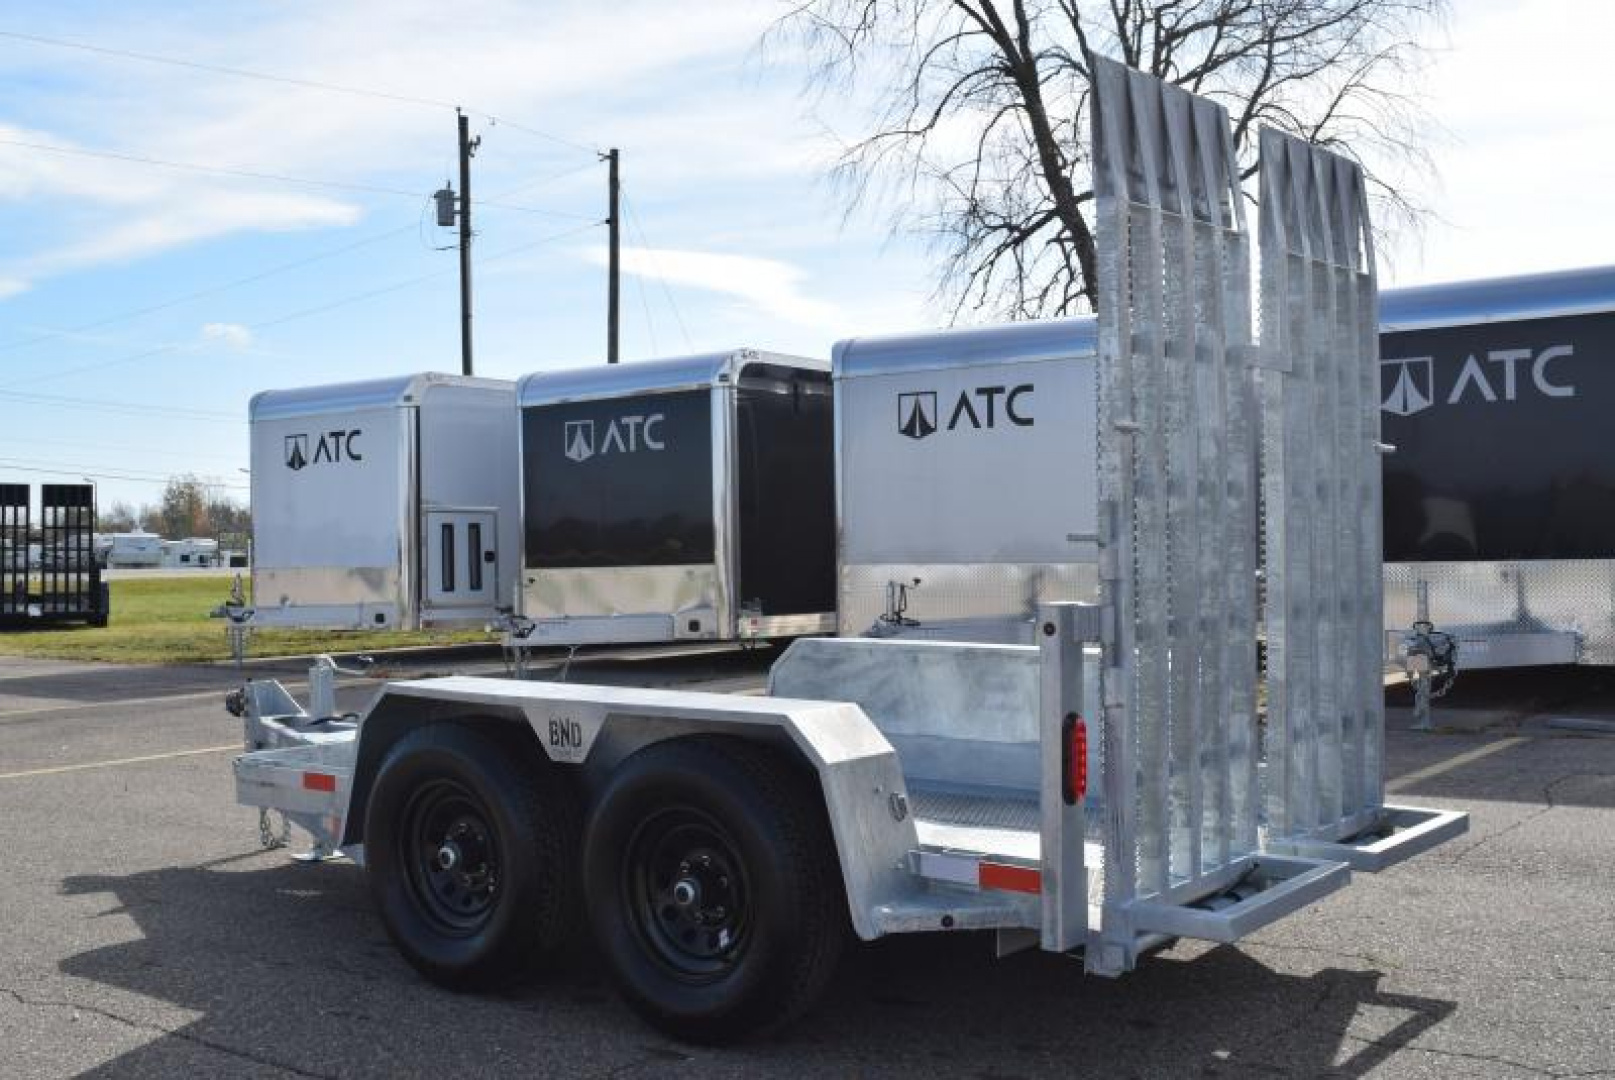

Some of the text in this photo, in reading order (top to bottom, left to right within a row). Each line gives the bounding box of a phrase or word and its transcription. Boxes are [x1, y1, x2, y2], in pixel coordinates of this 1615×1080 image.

[1447, 345, 1575, 404] ATC
[948, 384, 1034, 430] ATC
[313, 430, 362, 462] ATC
[601, 414, 665, 453] ATC
[549, 718, 582, 748] BND
